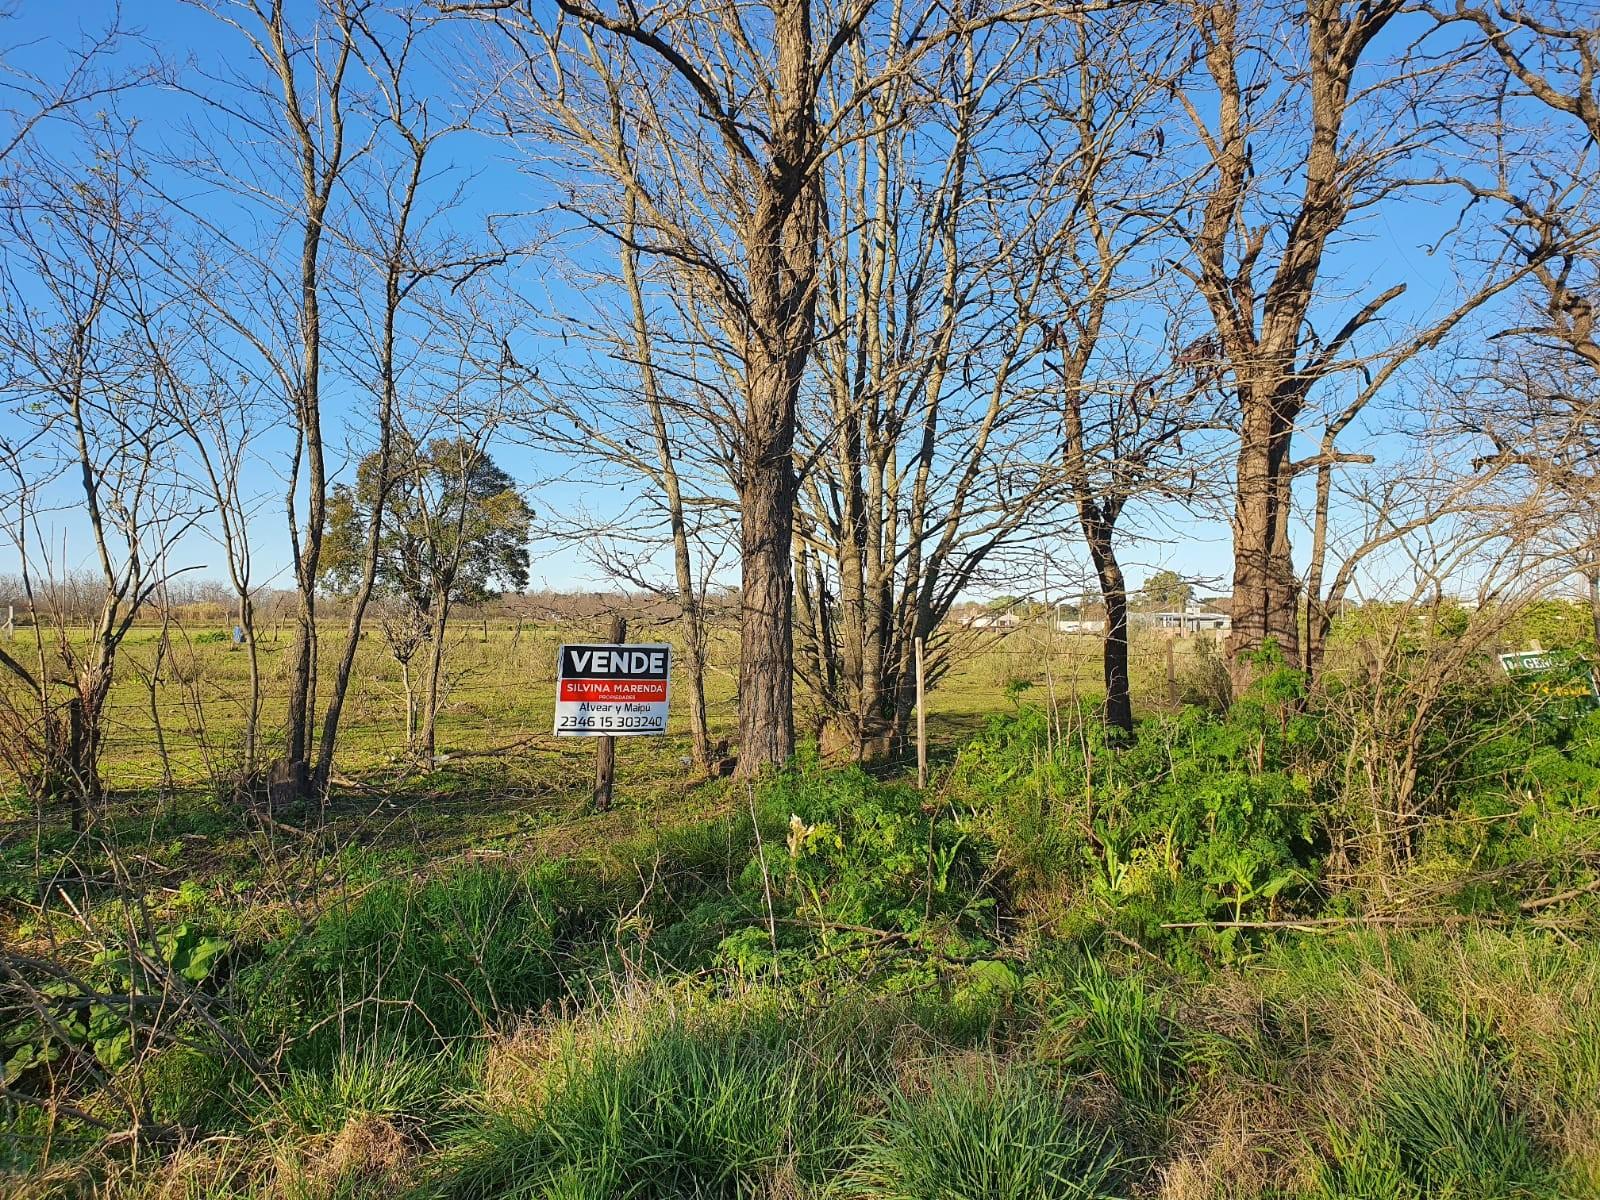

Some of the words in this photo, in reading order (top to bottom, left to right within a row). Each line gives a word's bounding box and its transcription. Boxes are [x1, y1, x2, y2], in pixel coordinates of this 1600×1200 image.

[570, 650, 665, 674] VENDE
[567, 683, 610, 692] SILVINA
[614, 684, 663, 693] MARENDA
[579, 702, 612, 712] Alvear
[615, 705, 622, 714] y
[624, 703, 651, 714] Maipú
[560, 716, 595, 727] 2346
[600, 716, 613, 727] 15
[617, 717, 662, 727] 303240
